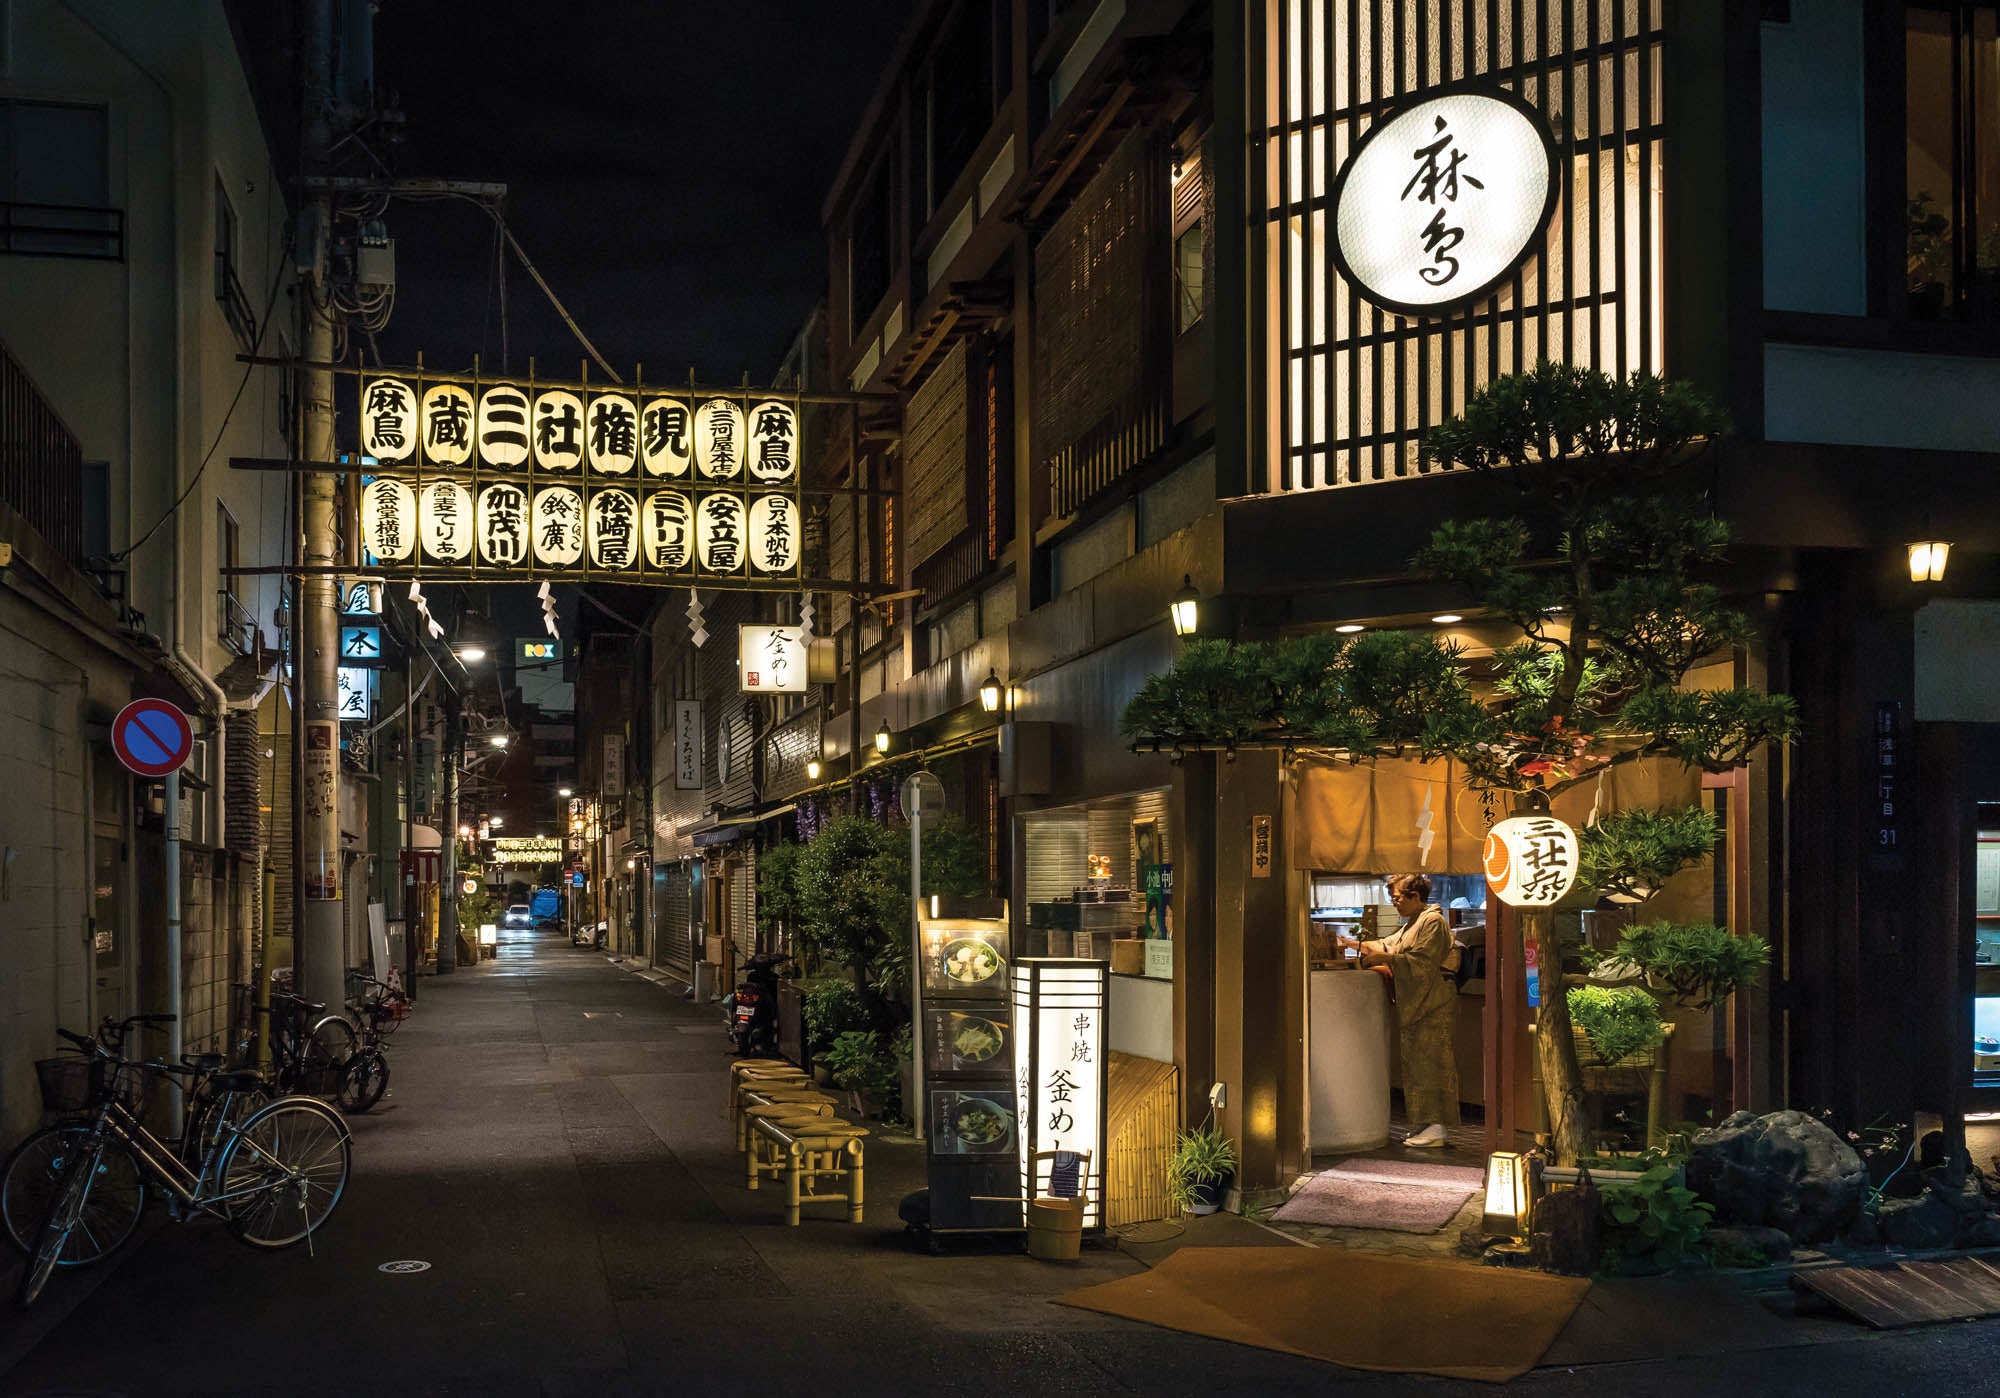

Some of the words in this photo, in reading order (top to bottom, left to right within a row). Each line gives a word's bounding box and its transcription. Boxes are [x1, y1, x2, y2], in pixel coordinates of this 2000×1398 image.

[366, 381, 409, 449] 麻鳥
[709, 410, 737, 474] 三河屋本店
[752, 405, 794, 472] 麻鳥
[373, 481, 402, 556] 公会堂横通り
[486, 487, 521, 560] 加茂川
[595, 491, 633, 566] 松崎屋
[653, 493, 690, 566] ミドリ屋
[705, 496, 741, 569] 安立屋
[764, 497, 791, 568] 日乃本帆布
[525, 643, 555, 658] ROX
[763, 628, 793, 688] 釜めし
[1881, 737, 1894, 816] 浅草一丁目
[1879, 829, 1897, 845] 31
[1146, 870, 1161, 888] 小池
[1070, 1012, 1092, 1063] 串焼
